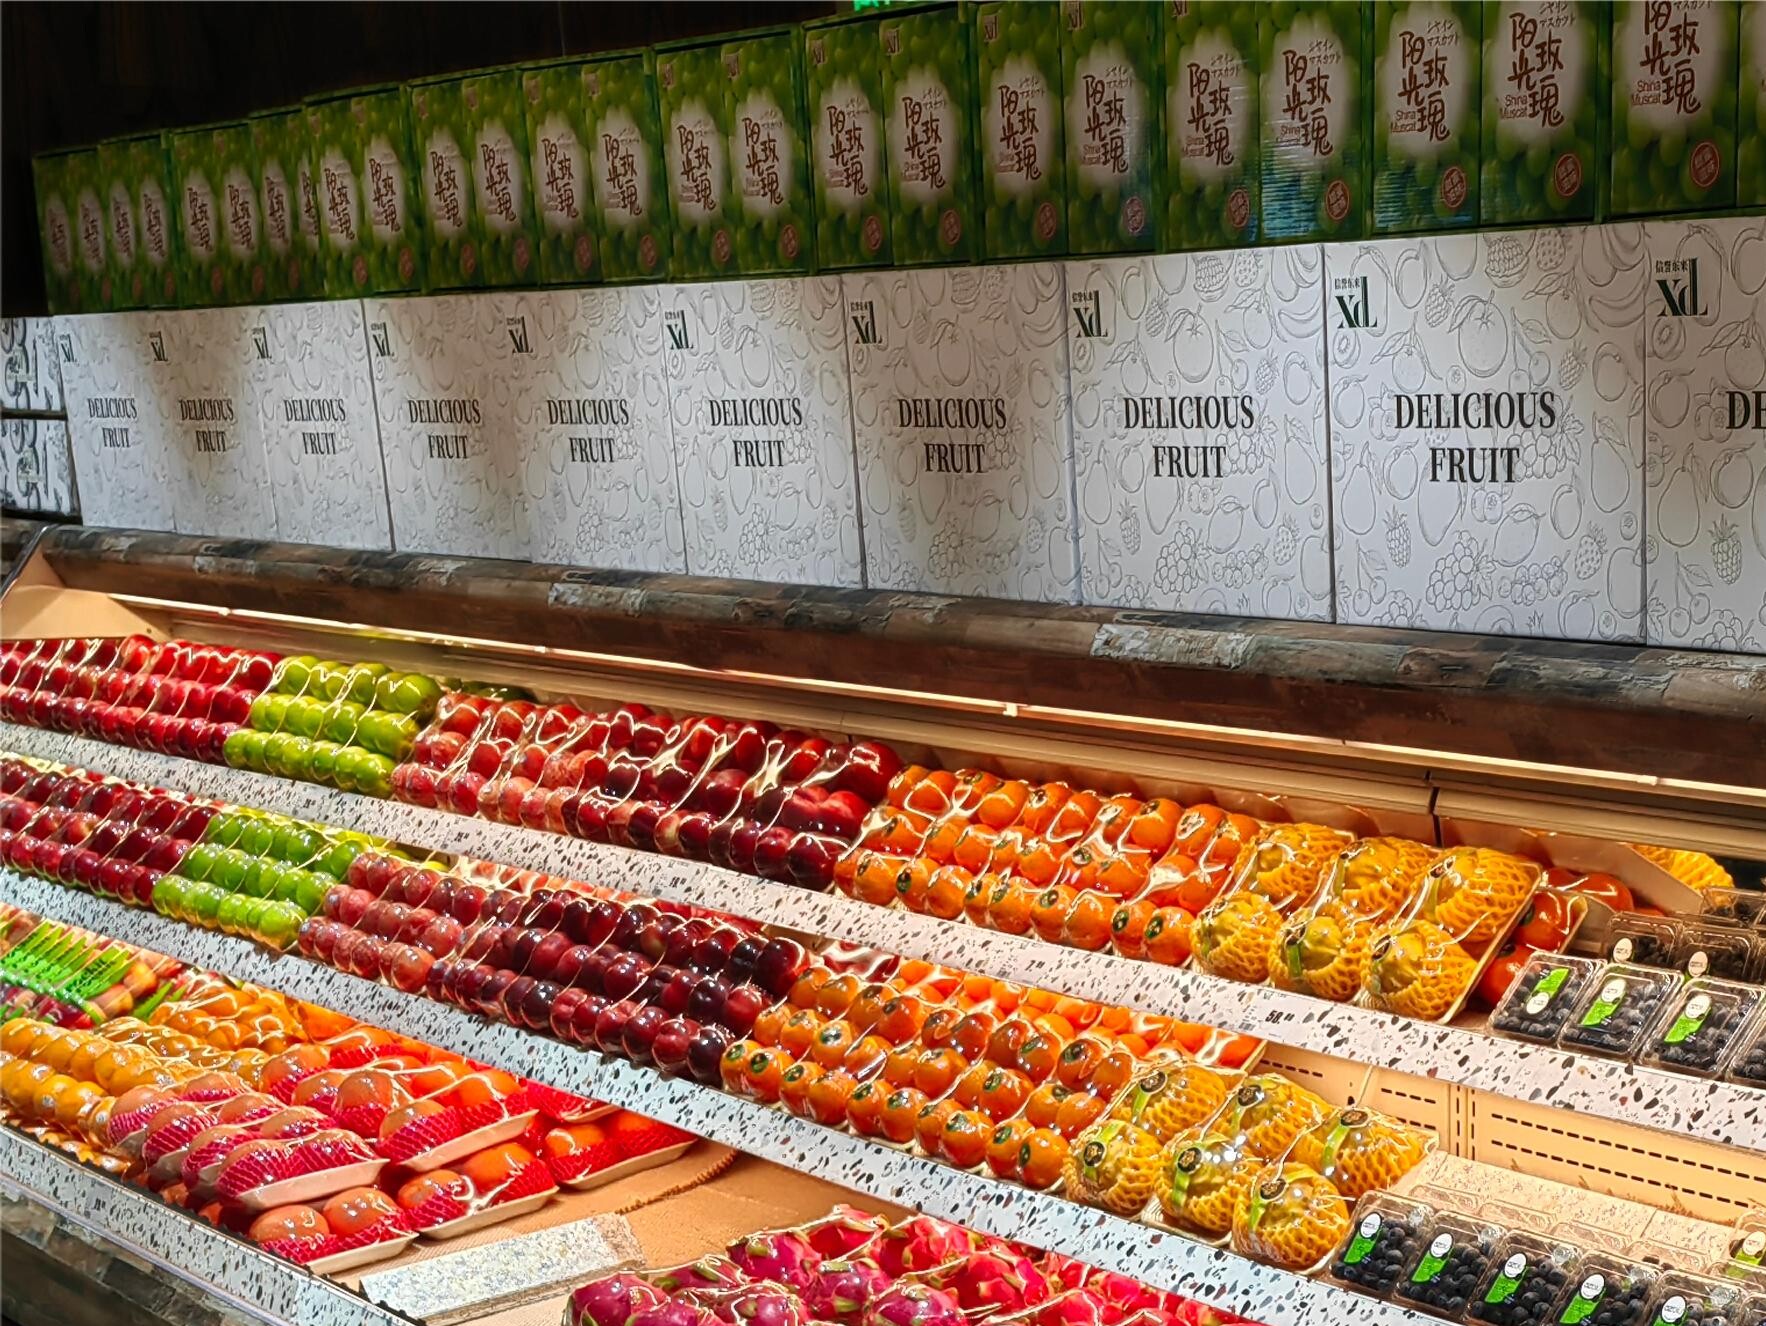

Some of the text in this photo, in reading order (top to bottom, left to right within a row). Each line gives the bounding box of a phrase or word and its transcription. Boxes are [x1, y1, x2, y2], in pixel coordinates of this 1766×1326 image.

[1655, 260, 1690, 276] 信誉东来
[87, 398, 137, 418] DELICIOUS
[179, 398, 233, 421] DELICIOUS
[283, 398, 346, 422] DELICIOUS
[408, 399, 481, 424] DELICIOUS
[547, 399, 629, 425] DELICIOUS
[709, 398, 802, 427] DELICIOUS
[899, 398, 1007, 429] DELICIOUS
[1124, 395, 1254, 430] DELICIOUS
[1394, 391, 1556, 431] DELICIOUS
[102, 427, 131, 448] FRUIT
[196, 430, 227, 453] FRUIT
[302, 431, 336, 456] FRUIT
[427, 434, 468, 459] FRUIT
[568, 436, 615, 464] FRUIT
[733, 438, 785, 467] FRUIT
[924, 442, 986, 474] FRUIT
[1152, 445, 1227, 480] FRUIT
[1429, 446, 1520, 484] FRUIT
